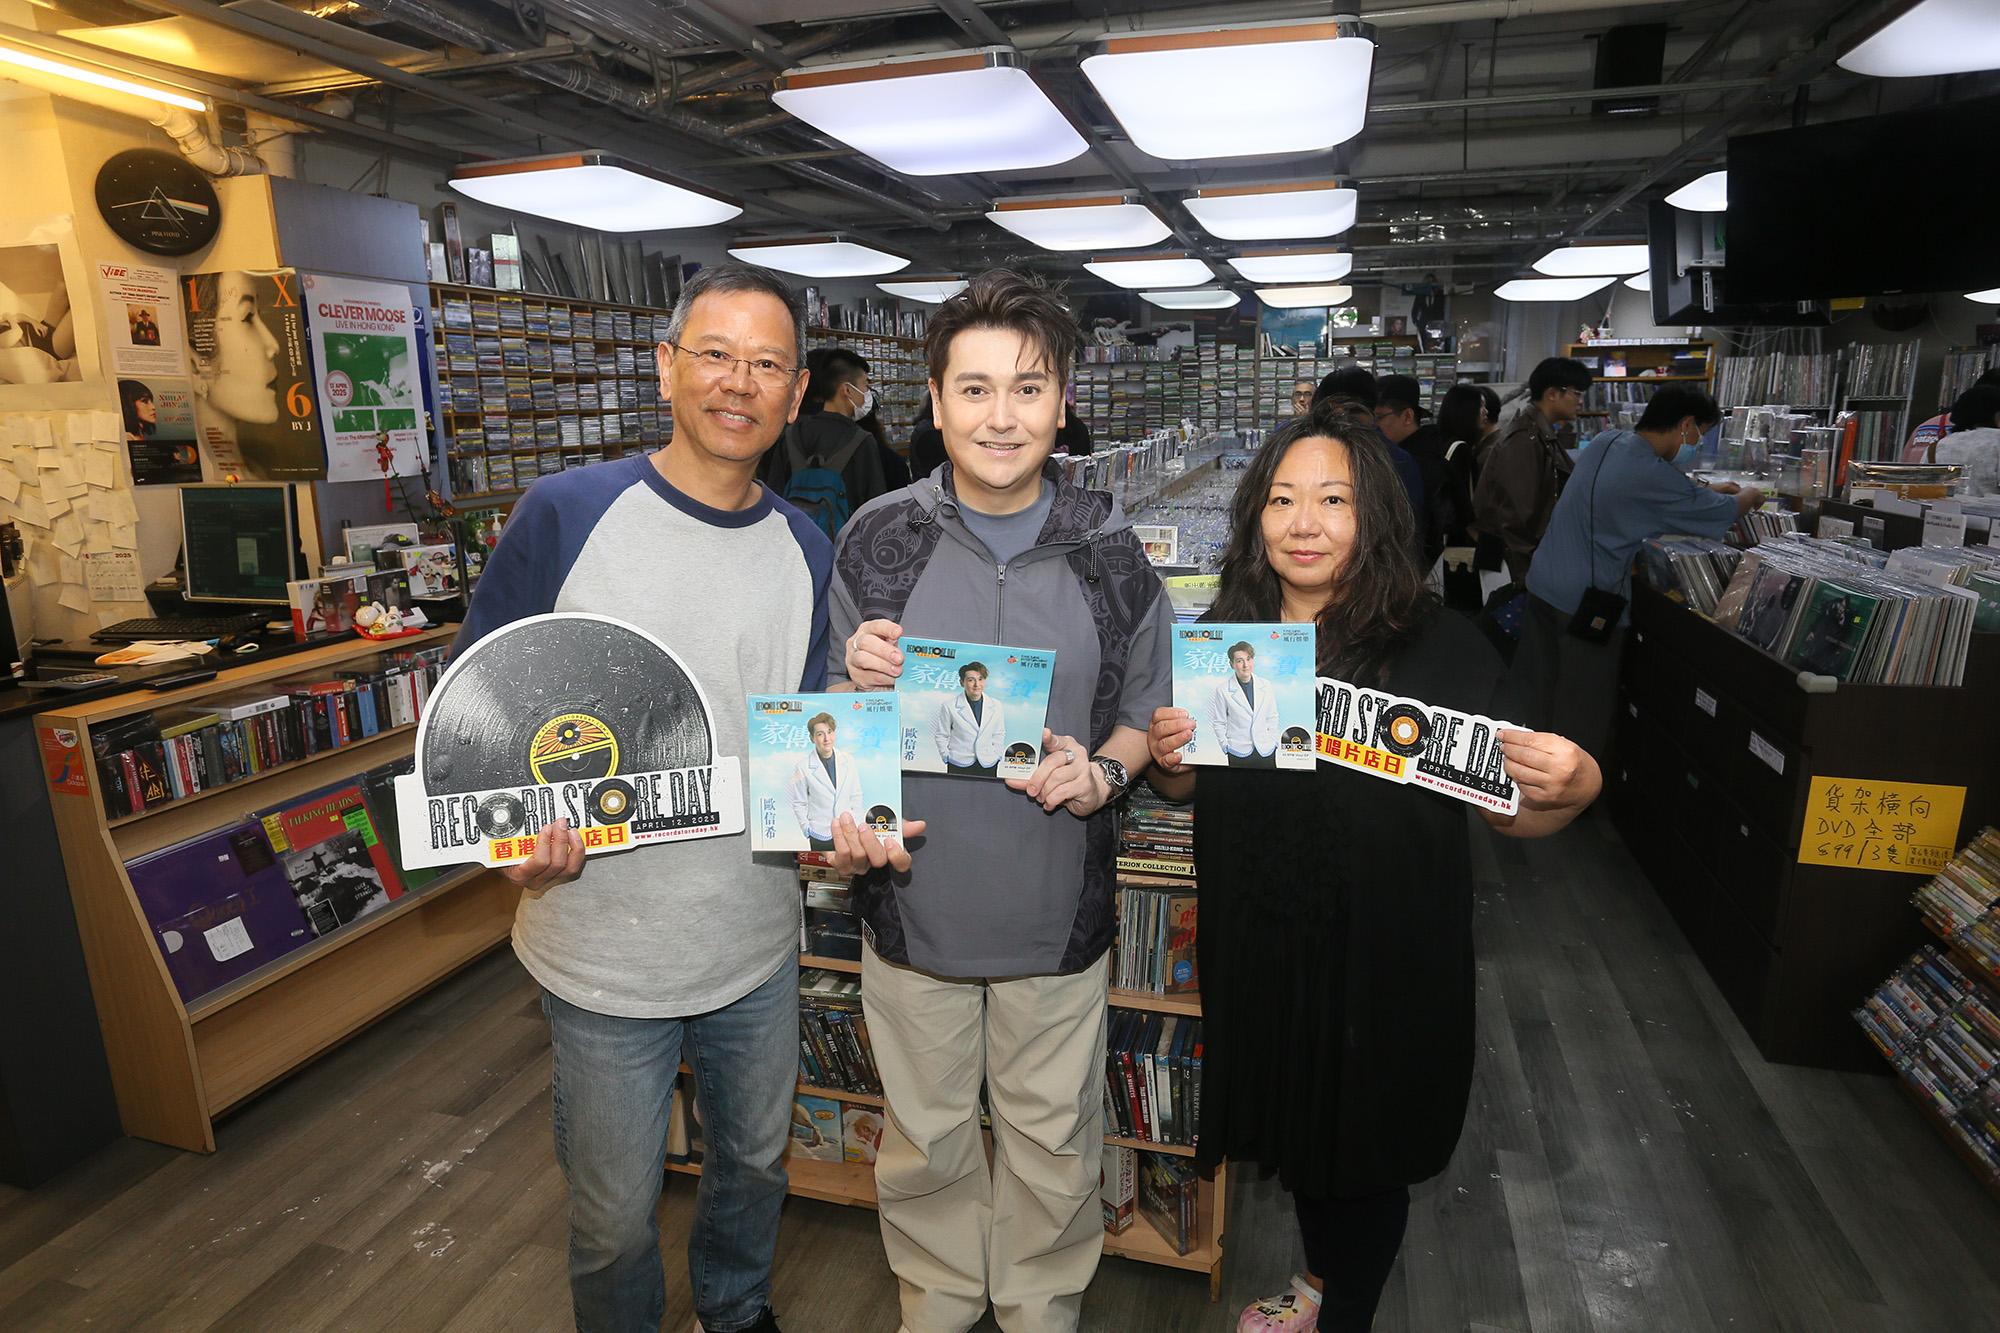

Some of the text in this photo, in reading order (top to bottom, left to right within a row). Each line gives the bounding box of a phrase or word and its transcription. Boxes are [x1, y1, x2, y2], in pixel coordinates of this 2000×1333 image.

[272, 274, 297, 308] X
[318, 303, 406, 323] CLEVER MOOSE
[335, 320, 395, 332] LIVE IN HONG KONG
[286, 382, 312, 418] 6
[292, 421, 312, 431] BY J
[1352, 694, 1464, 768] STORE
[1465, 722, 1513, 788] DA
[1414, 774, 1512, 811] www.recordstoreday.hk
[1422, 764, 1452, 779] APRIL
[1481, 780, 1508, 796] 2025
[288, 797, 354, 827] TALKING HEADS
[428, 767, 713, 849] RECORD STORE DAY
[634, 826, 719, 840] www.recordstoreday.hk
[636, 821, 666, 831] APRIL
[1816, 818, 1856, 838] DVD
[495, 826, 623, 859] 香港店日
[1142, 863, 1186, 872] COLLECTION
